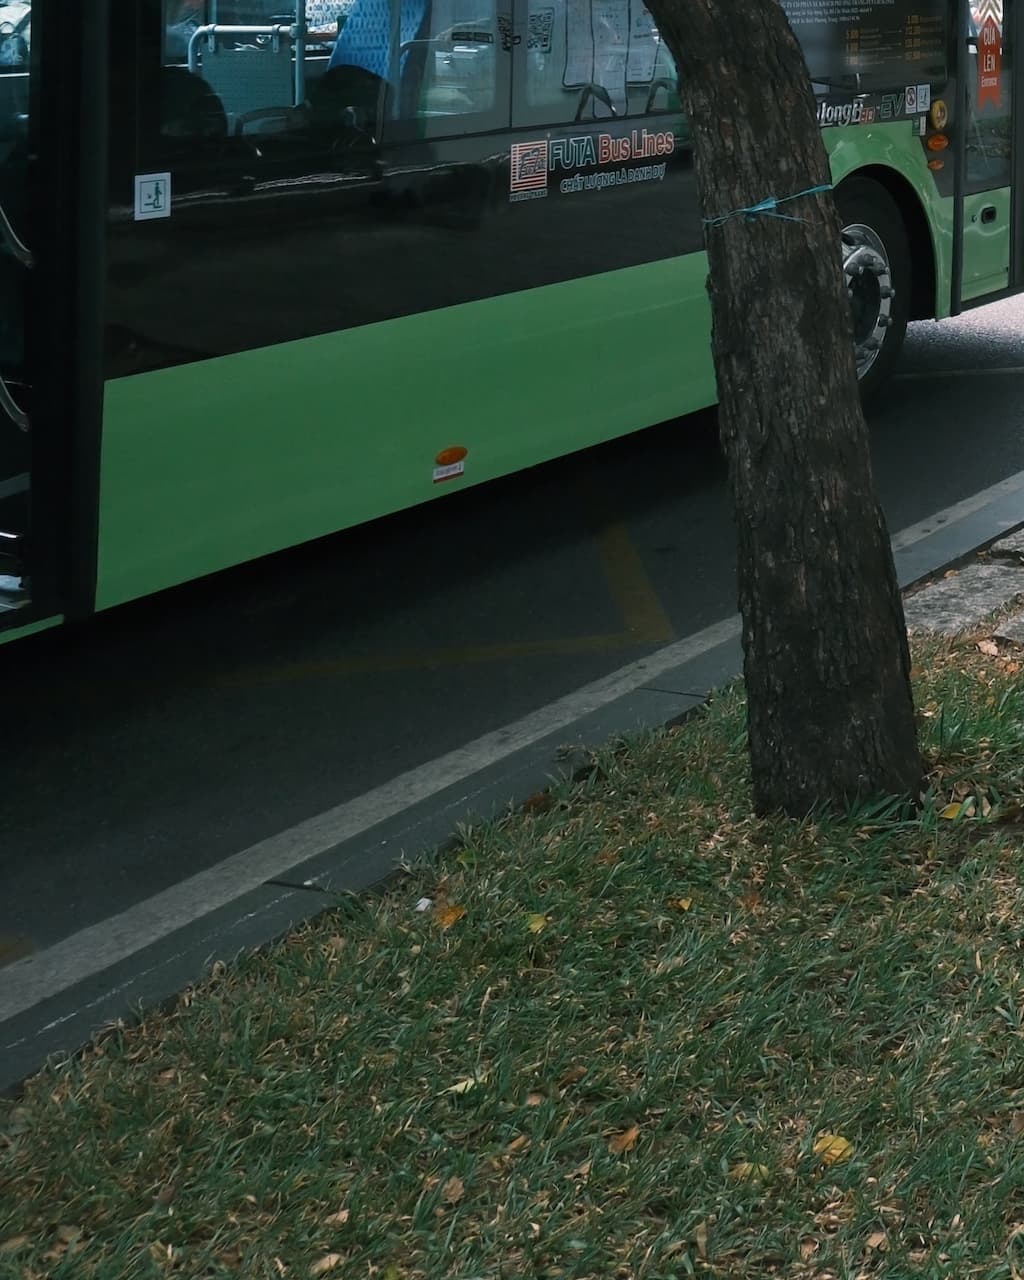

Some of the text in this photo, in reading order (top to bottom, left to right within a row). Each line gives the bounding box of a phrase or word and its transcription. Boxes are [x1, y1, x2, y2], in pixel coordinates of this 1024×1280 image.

[550, 128, 675, 171] FUTA Bus Lines
